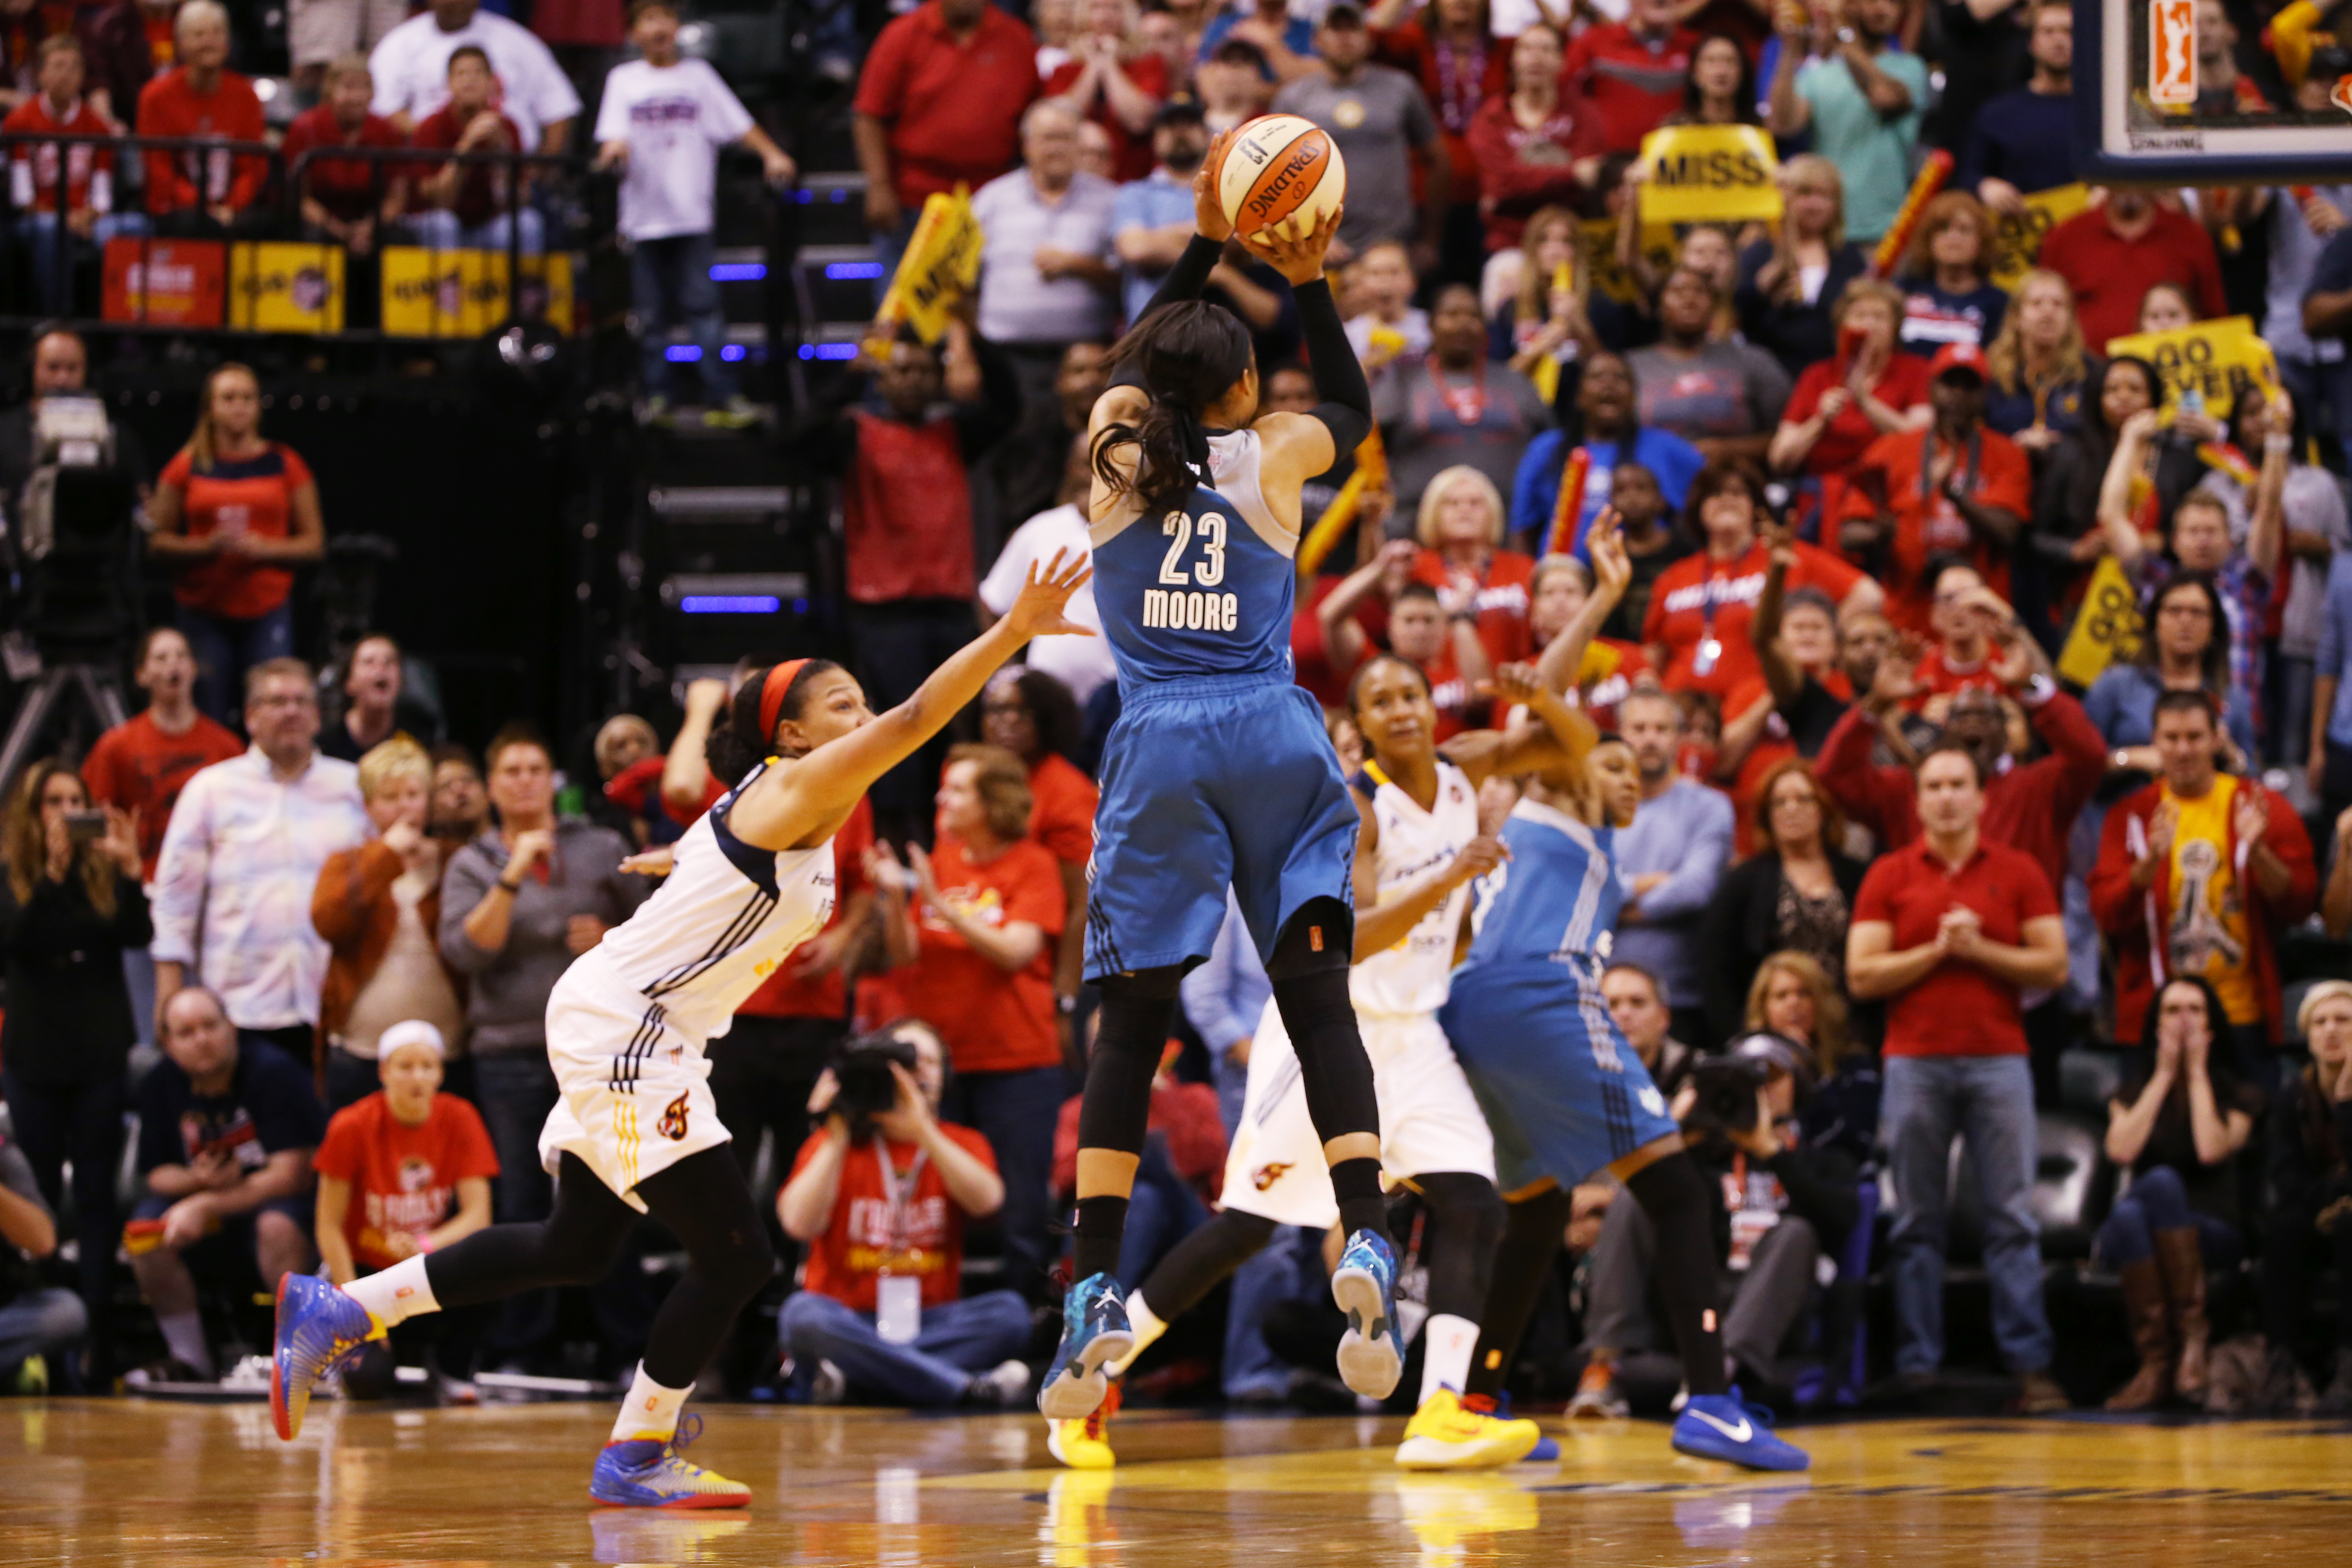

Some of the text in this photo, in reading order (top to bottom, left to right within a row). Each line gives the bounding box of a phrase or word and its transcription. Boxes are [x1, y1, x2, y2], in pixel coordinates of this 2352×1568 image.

[1249, 140, 1319, 218] SPALDING
[1653, 151, 1766, 189] MISS
[2155, 336, 2212, 370] GO
[1158, 510, 1227, 587] 23
[1142, 588, 1238, 632] MOORE
